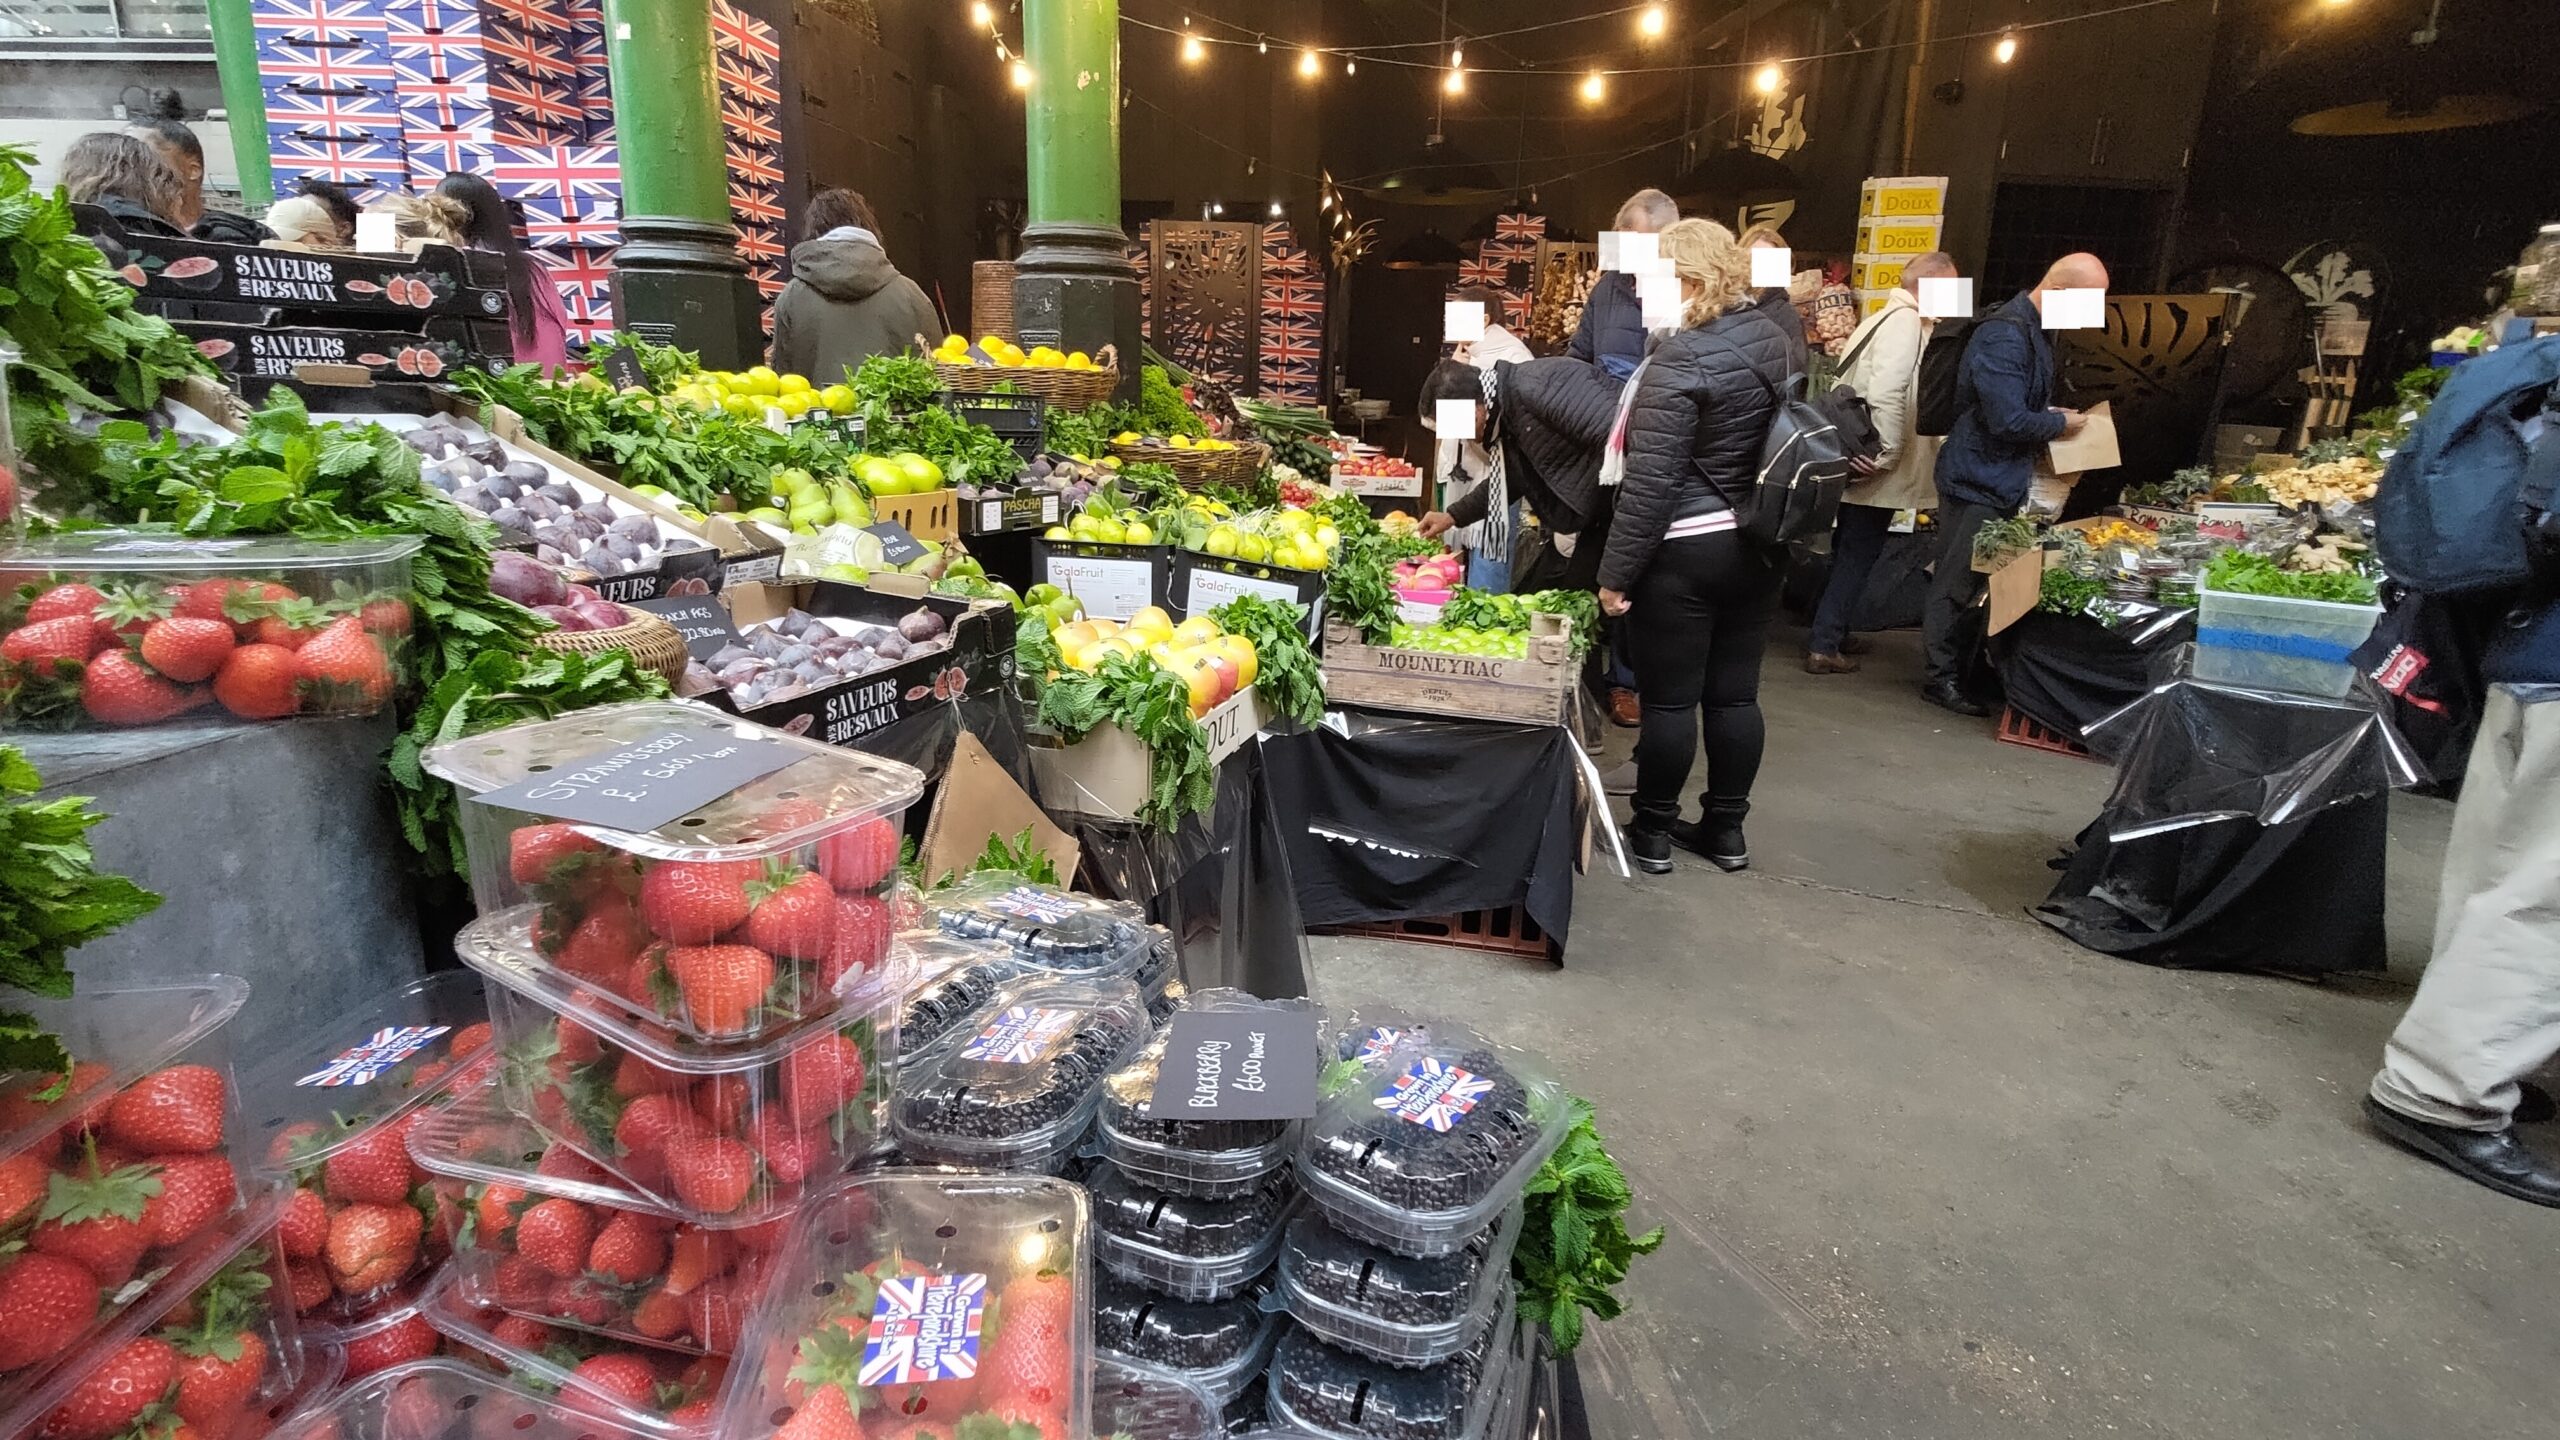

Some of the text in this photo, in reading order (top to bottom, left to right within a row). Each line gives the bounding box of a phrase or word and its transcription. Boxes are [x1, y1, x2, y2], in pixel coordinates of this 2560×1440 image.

[1886, 196, 1932, 210] Doux
[1883, 235, 1928, 248] Doux
[235, 255, 334, 282] SAVEURS
[251, 279, 337, 302] RESVAUX
[250, 335, 345, 358] SAVEURS
[1003, 497, 1041, 512] PASCHA
[1055, 565, 1104, 578] GalaFruit
[1196, 577, 1248, 595] GalaFruit
[1378, 652, 1504, 679] MOUNEYRAC
[826, 678, 898, 722] SAVEURS
[837, 701, 899, 742] RESVAUX
[527, 732, 693, 800] STRAWBERRY
[1188, 1040, 1232, 1107] BLACKBERRY
[1395, 1078, 1427, 1101] Grown
[910, 1285, 957, 1369] Herefordshire
[949, 1294, 972, 1354] Grown in
